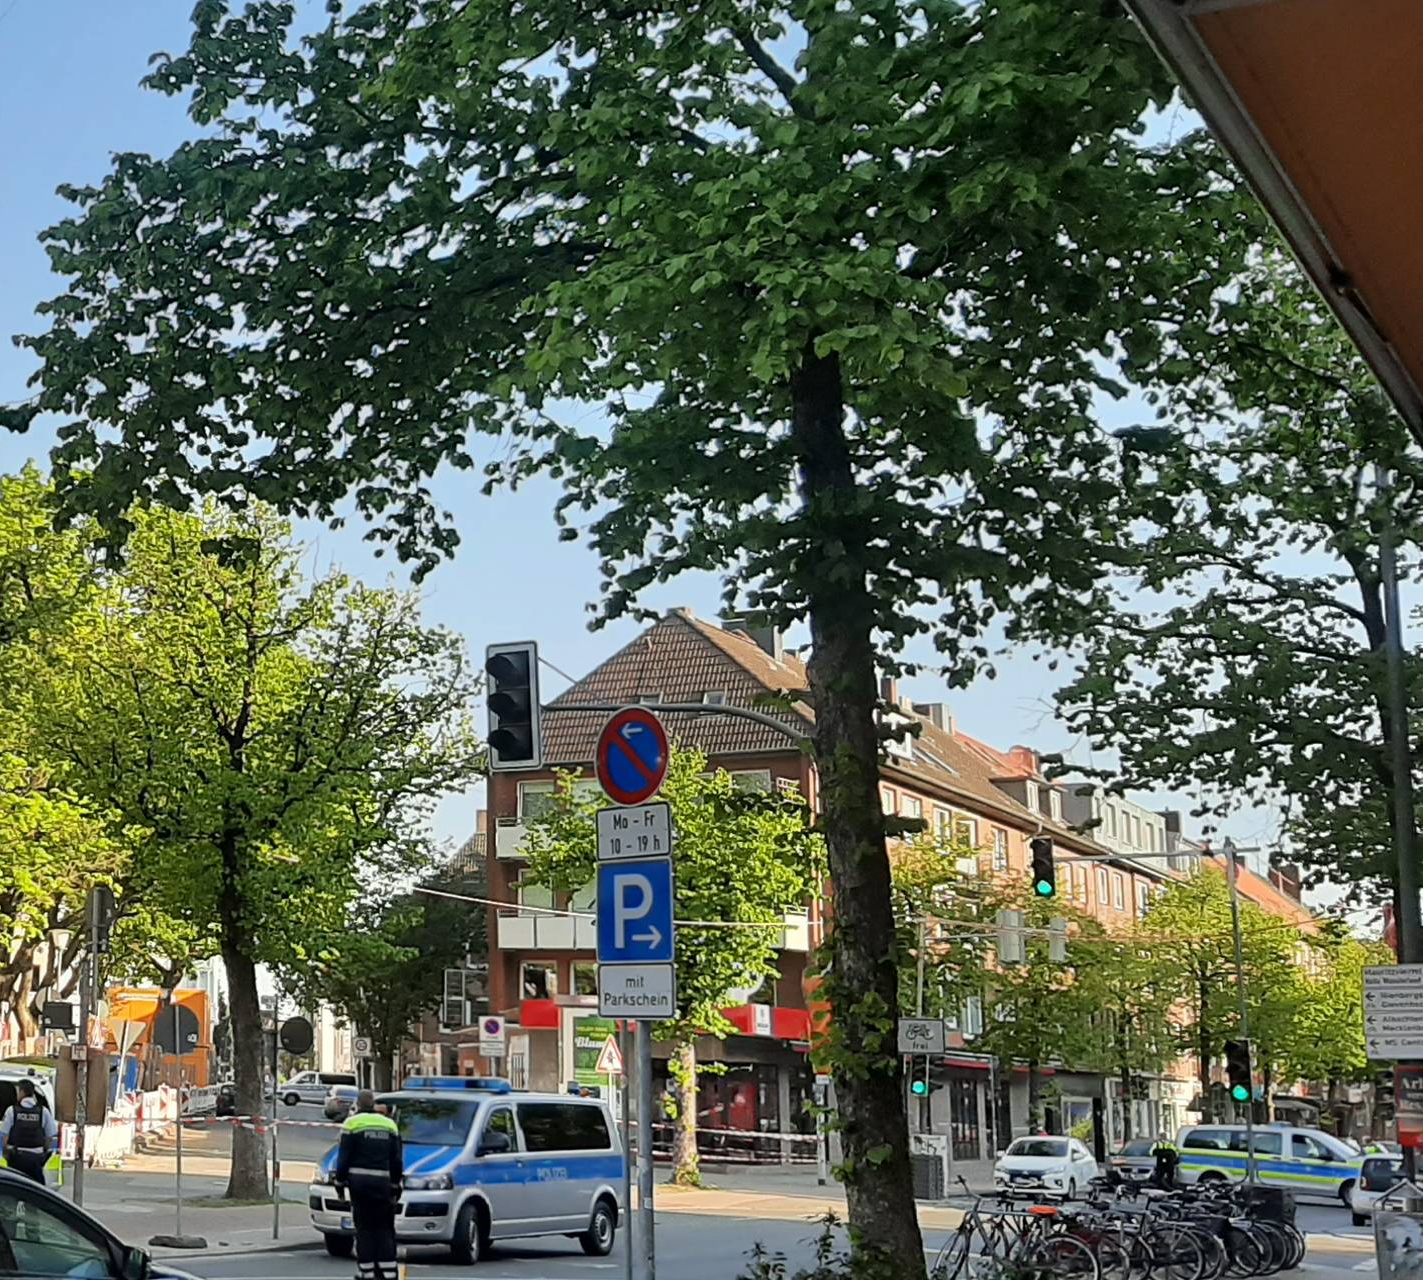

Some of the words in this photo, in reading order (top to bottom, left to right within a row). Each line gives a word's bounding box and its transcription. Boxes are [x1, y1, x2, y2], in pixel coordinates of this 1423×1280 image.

[613, 813, 628, 830] Mo
[644, 811, 656, 829] Fr
[610, 838, 621, 854] 10
[638, 835, 649, 851] 19
[653, 835, 661, 850] h
[613, 873, 654, 949] P
[626, 976, 644, 988] mit
[604, 992, 668, 1006] Parkschein
